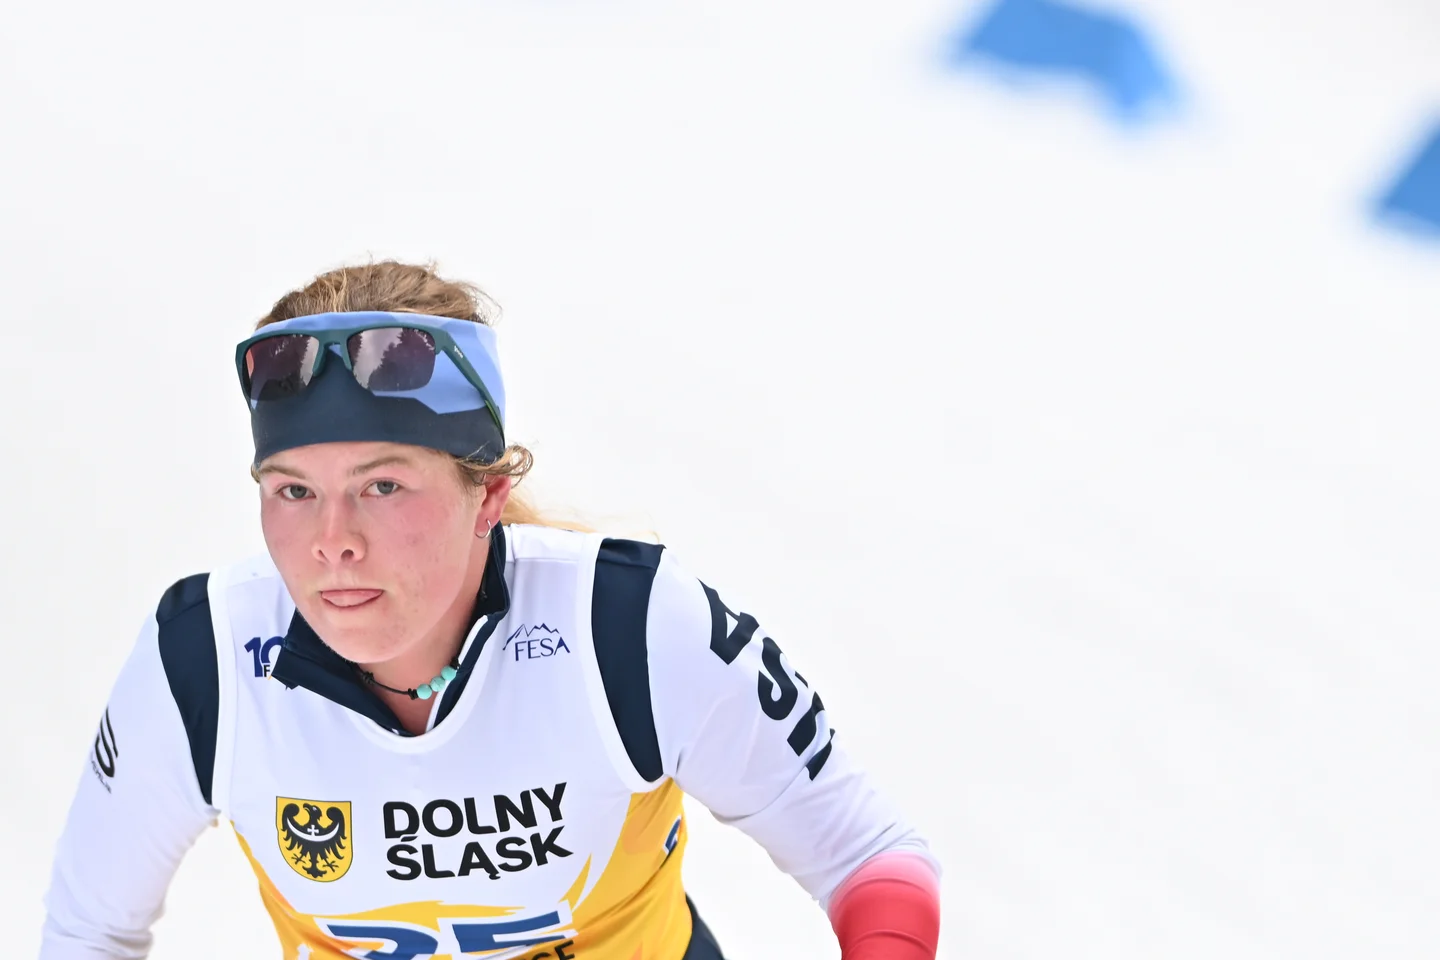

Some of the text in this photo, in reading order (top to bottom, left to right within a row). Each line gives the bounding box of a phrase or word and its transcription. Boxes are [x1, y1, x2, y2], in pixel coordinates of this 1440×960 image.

[514, 636, 571, 662] FESA
[382, 782, 567, 839] DOLNY
[385, 825, 573, 881] ŚLĄSK
